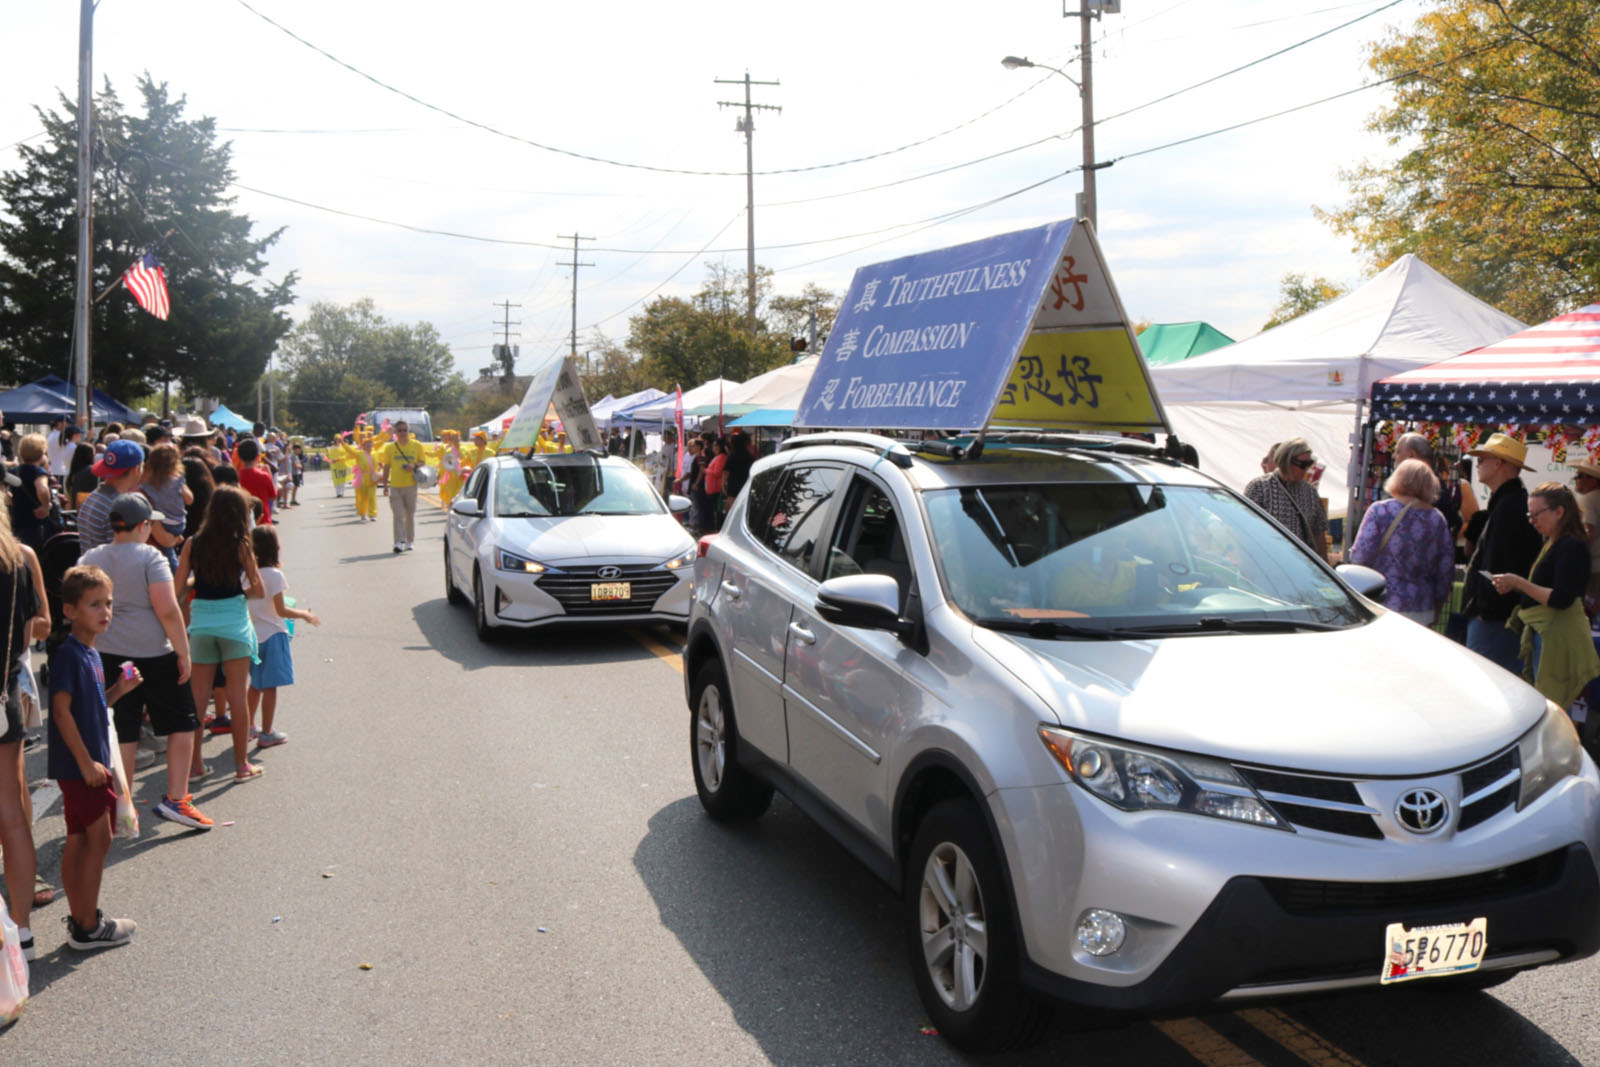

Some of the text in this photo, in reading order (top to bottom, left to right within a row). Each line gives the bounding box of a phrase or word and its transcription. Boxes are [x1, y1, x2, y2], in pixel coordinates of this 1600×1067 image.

[853, 278, 881, 314] 真
[883, 258, 1031, 308] TRUTHFULNESS
[1041, 255, 1089, 312] 好
[835, 327, 861, 362] 善
[863, 321, 976, 359] COMPASSION
[813, 378, 840, 411] 忍
[838, 376, 966, 410] FORBEARANCE
